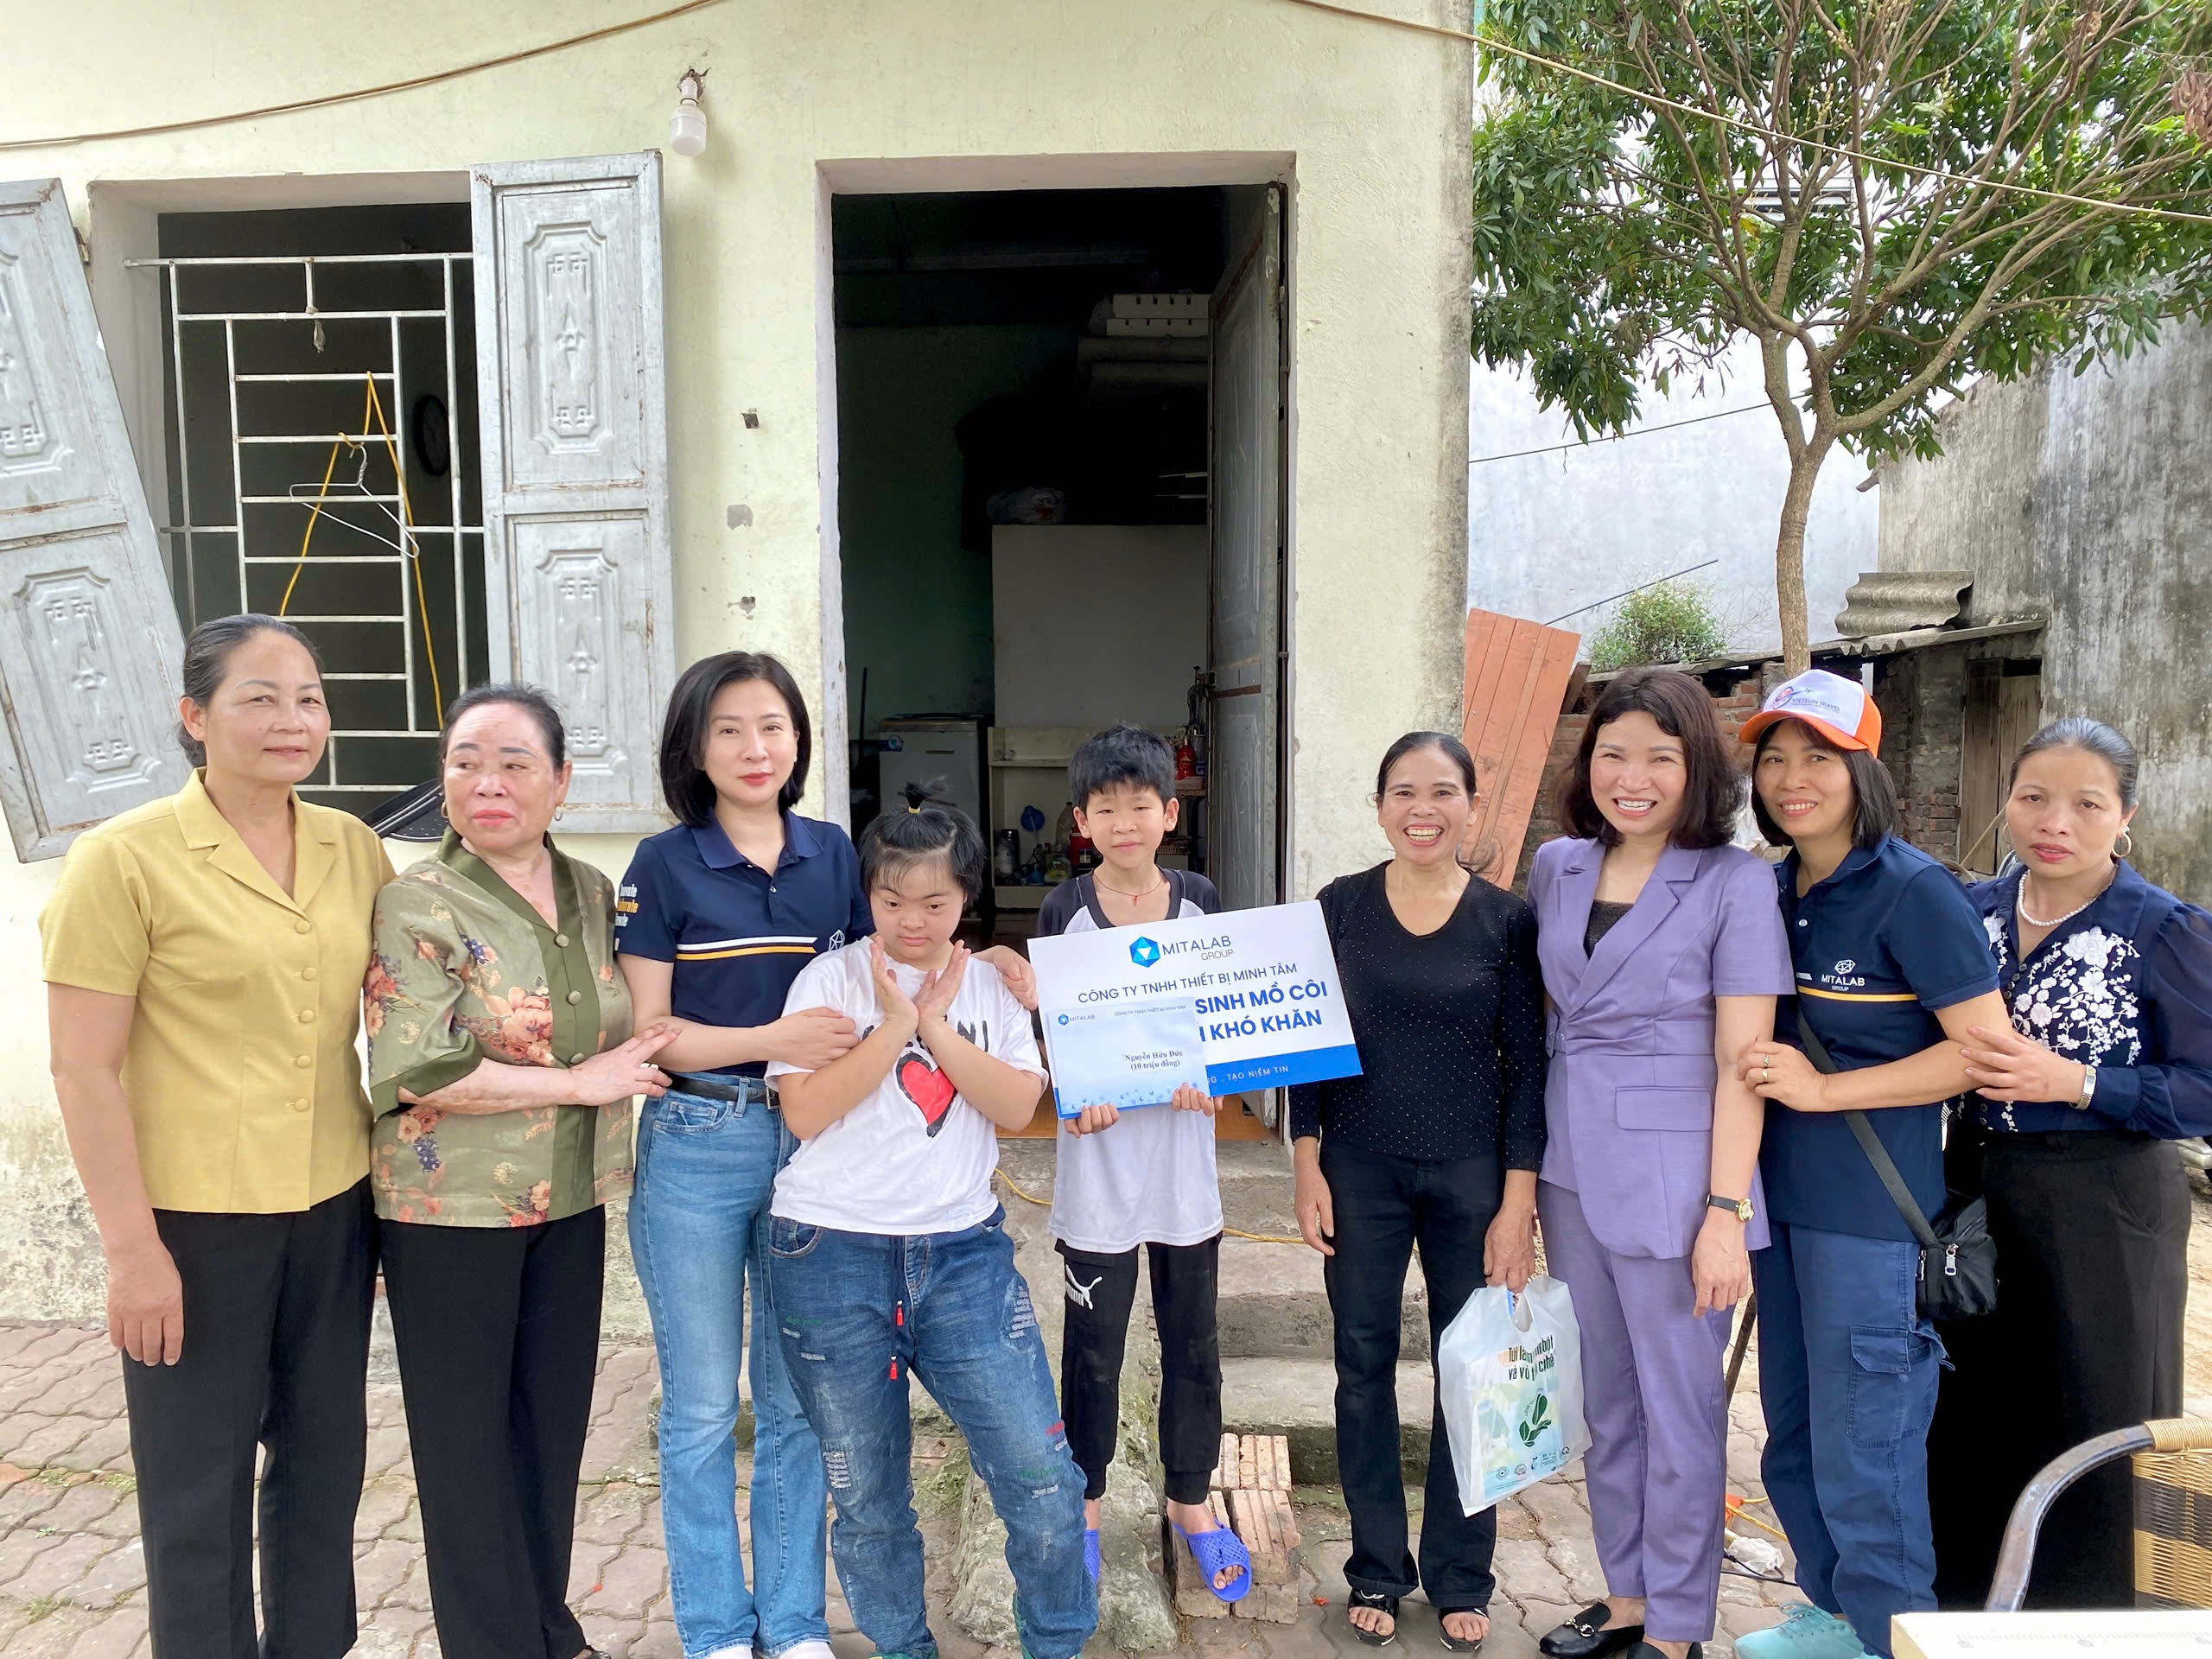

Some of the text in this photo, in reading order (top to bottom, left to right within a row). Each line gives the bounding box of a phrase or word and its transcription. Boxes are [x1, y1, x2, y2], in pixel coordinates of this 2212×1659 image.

[1162, 936, 1231, 956] MITALAB
[1201, 949, 1234, 961] GROUP
[1077, 963, 1298, 1003] CÔNG TY TNHH THIẾT BỊ MINH TÂM
[1821, 974, 1866, 986] MITALAB
[1195, 979, 1328, 1014] SINH MỒ CÔI
[1210, 1015, 1257, 1041] KHÓ
[1261, 1009, 1323, 1033] KHĂN
[1125, 1052, 1151, 1062] Nguyễn
[1130, 1058, 1181, 1071] (10 triệu đồng)
[1227, 1072, 1245, 1083] TẠO
[1274, 1065, 1289, 1074] TIN
[1509, 1346, 1518, 1363] Túi
